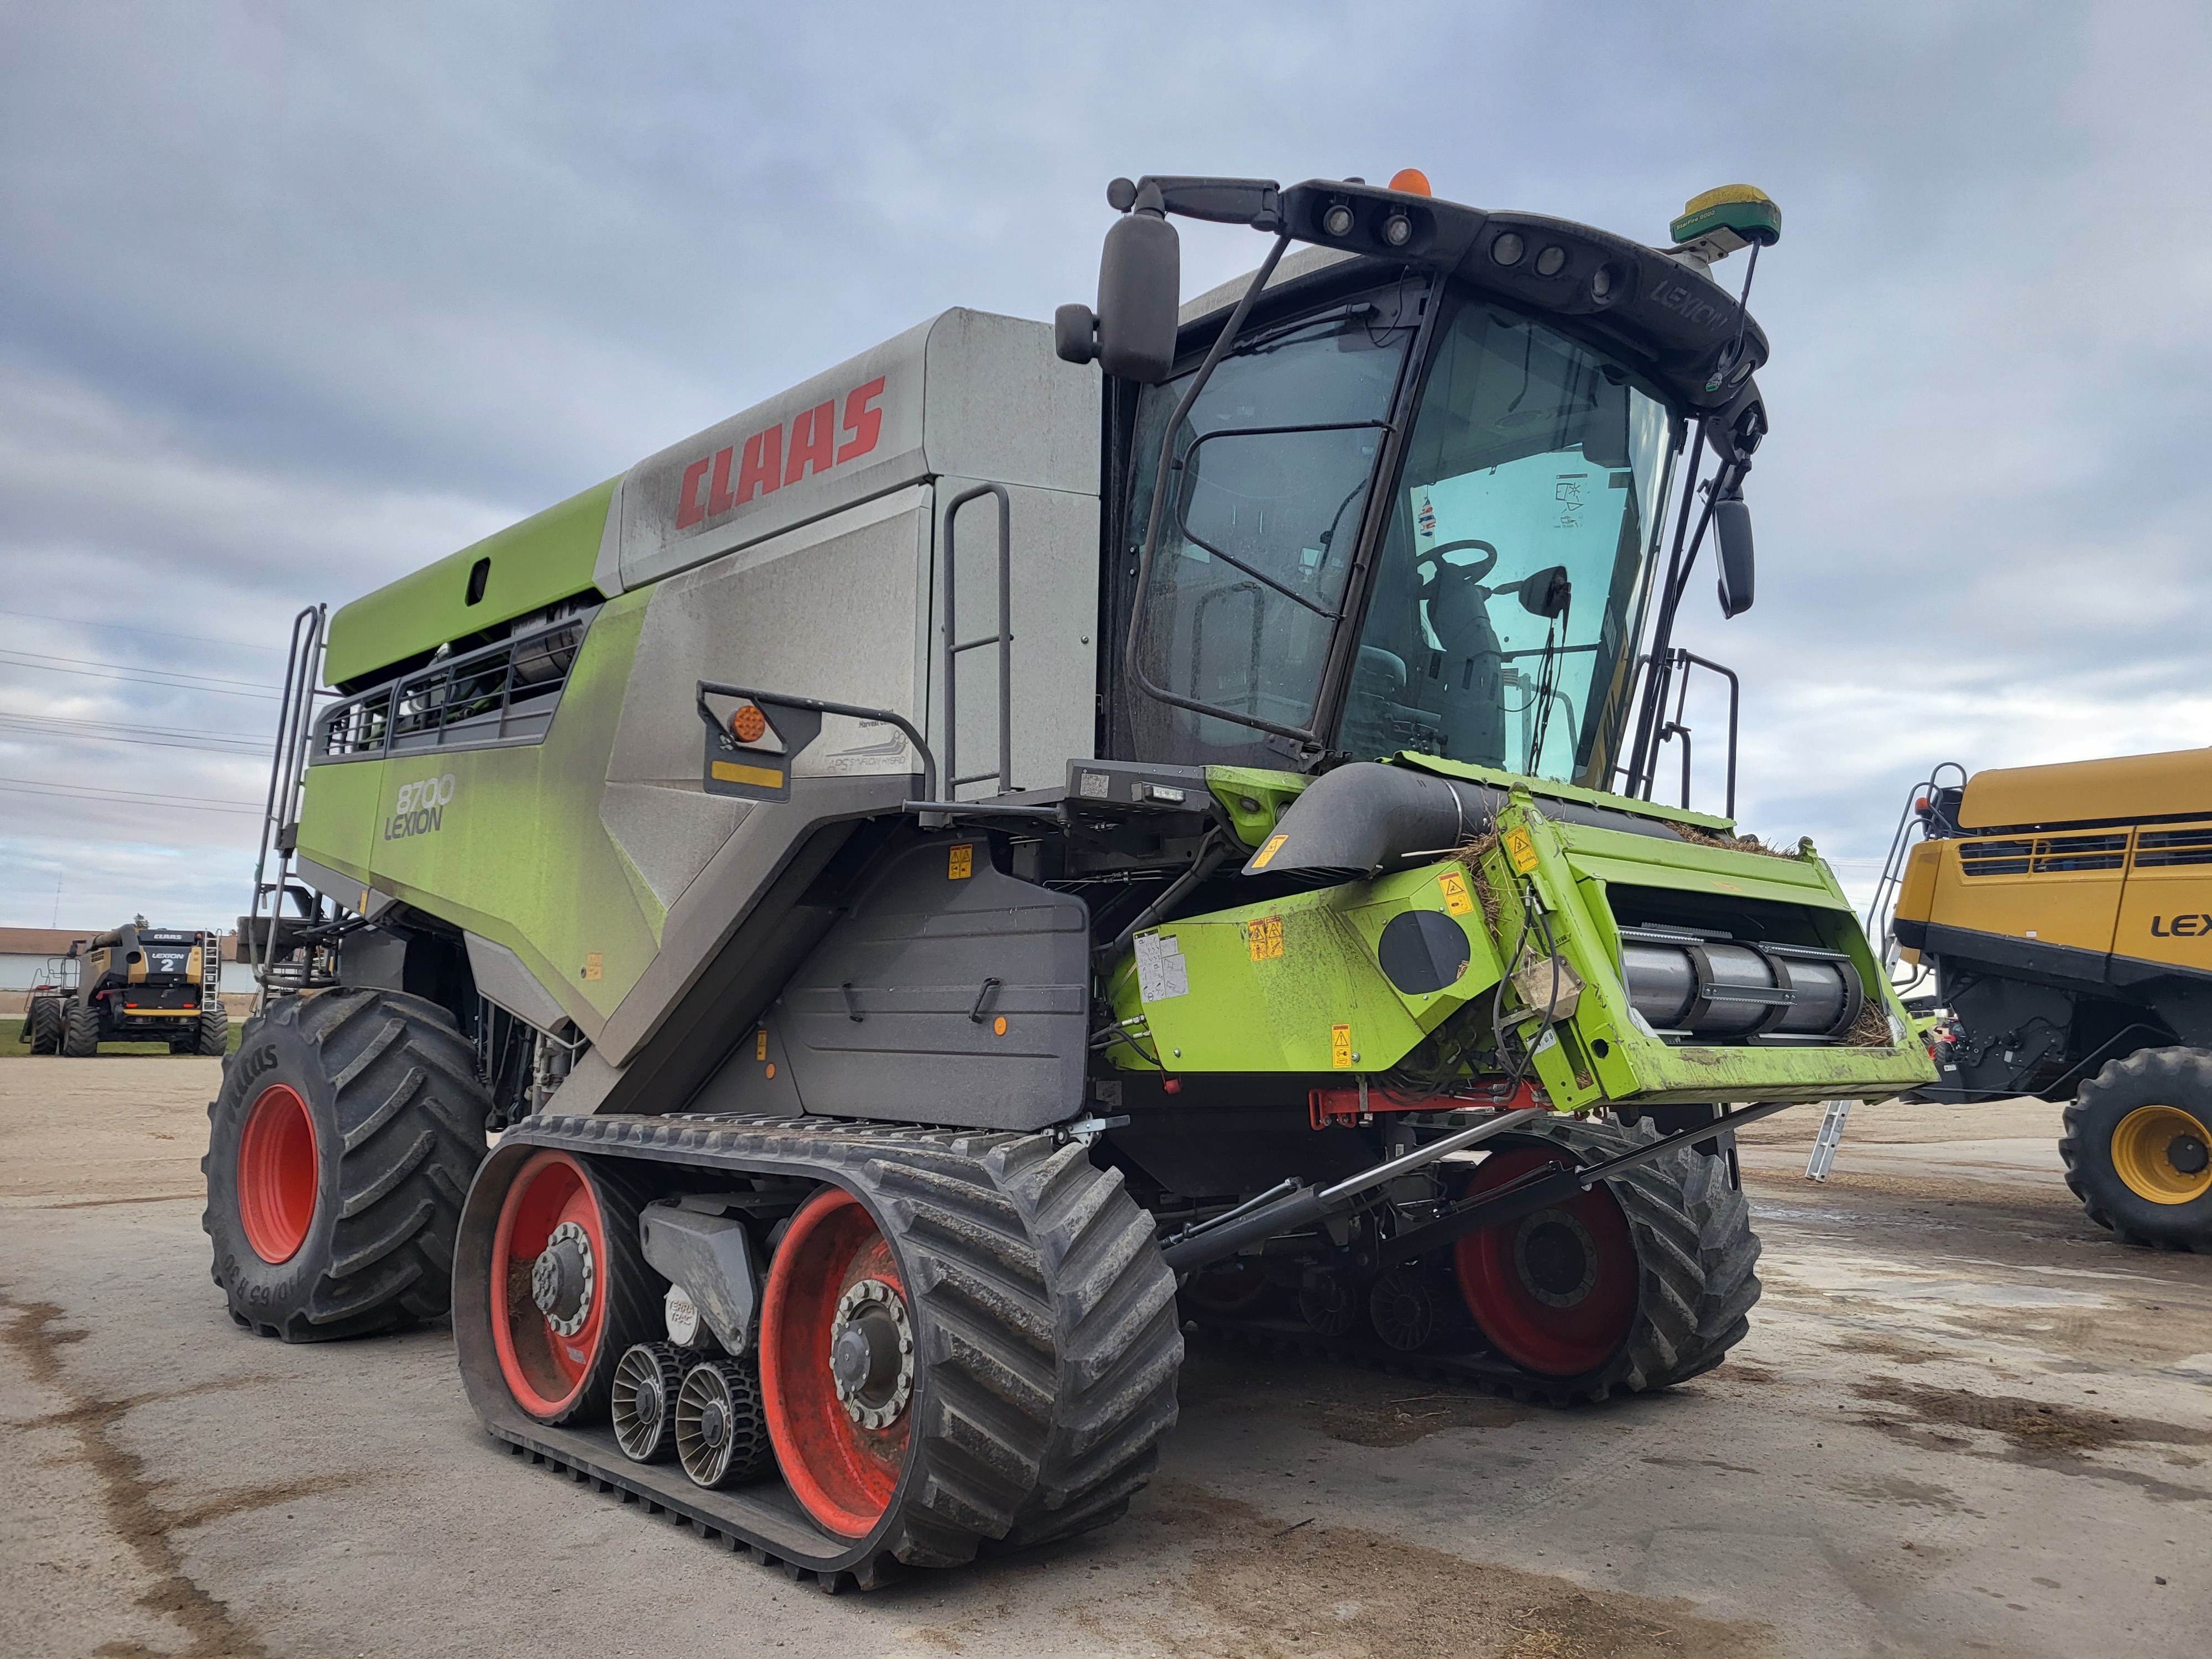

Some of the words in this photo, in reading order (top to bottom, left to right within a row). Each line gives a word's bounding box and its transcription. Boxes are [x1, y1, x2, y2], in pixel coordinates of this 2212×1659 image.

[1676, 217, 1698, 230] StarFire
[1700, 210, 1715, 220] 6000
[1650, 280, 1728, 332] LEXION
[676, 374, 885, 530] CLAAS
[396, 773, 455, 815] 8700
[384, 805, 444, 841] LEXION
[160, 959, 174, 972] 2
[669, 1300, 695, 1316] TERRA
[671, 1312, 692, 1326] TRAC
